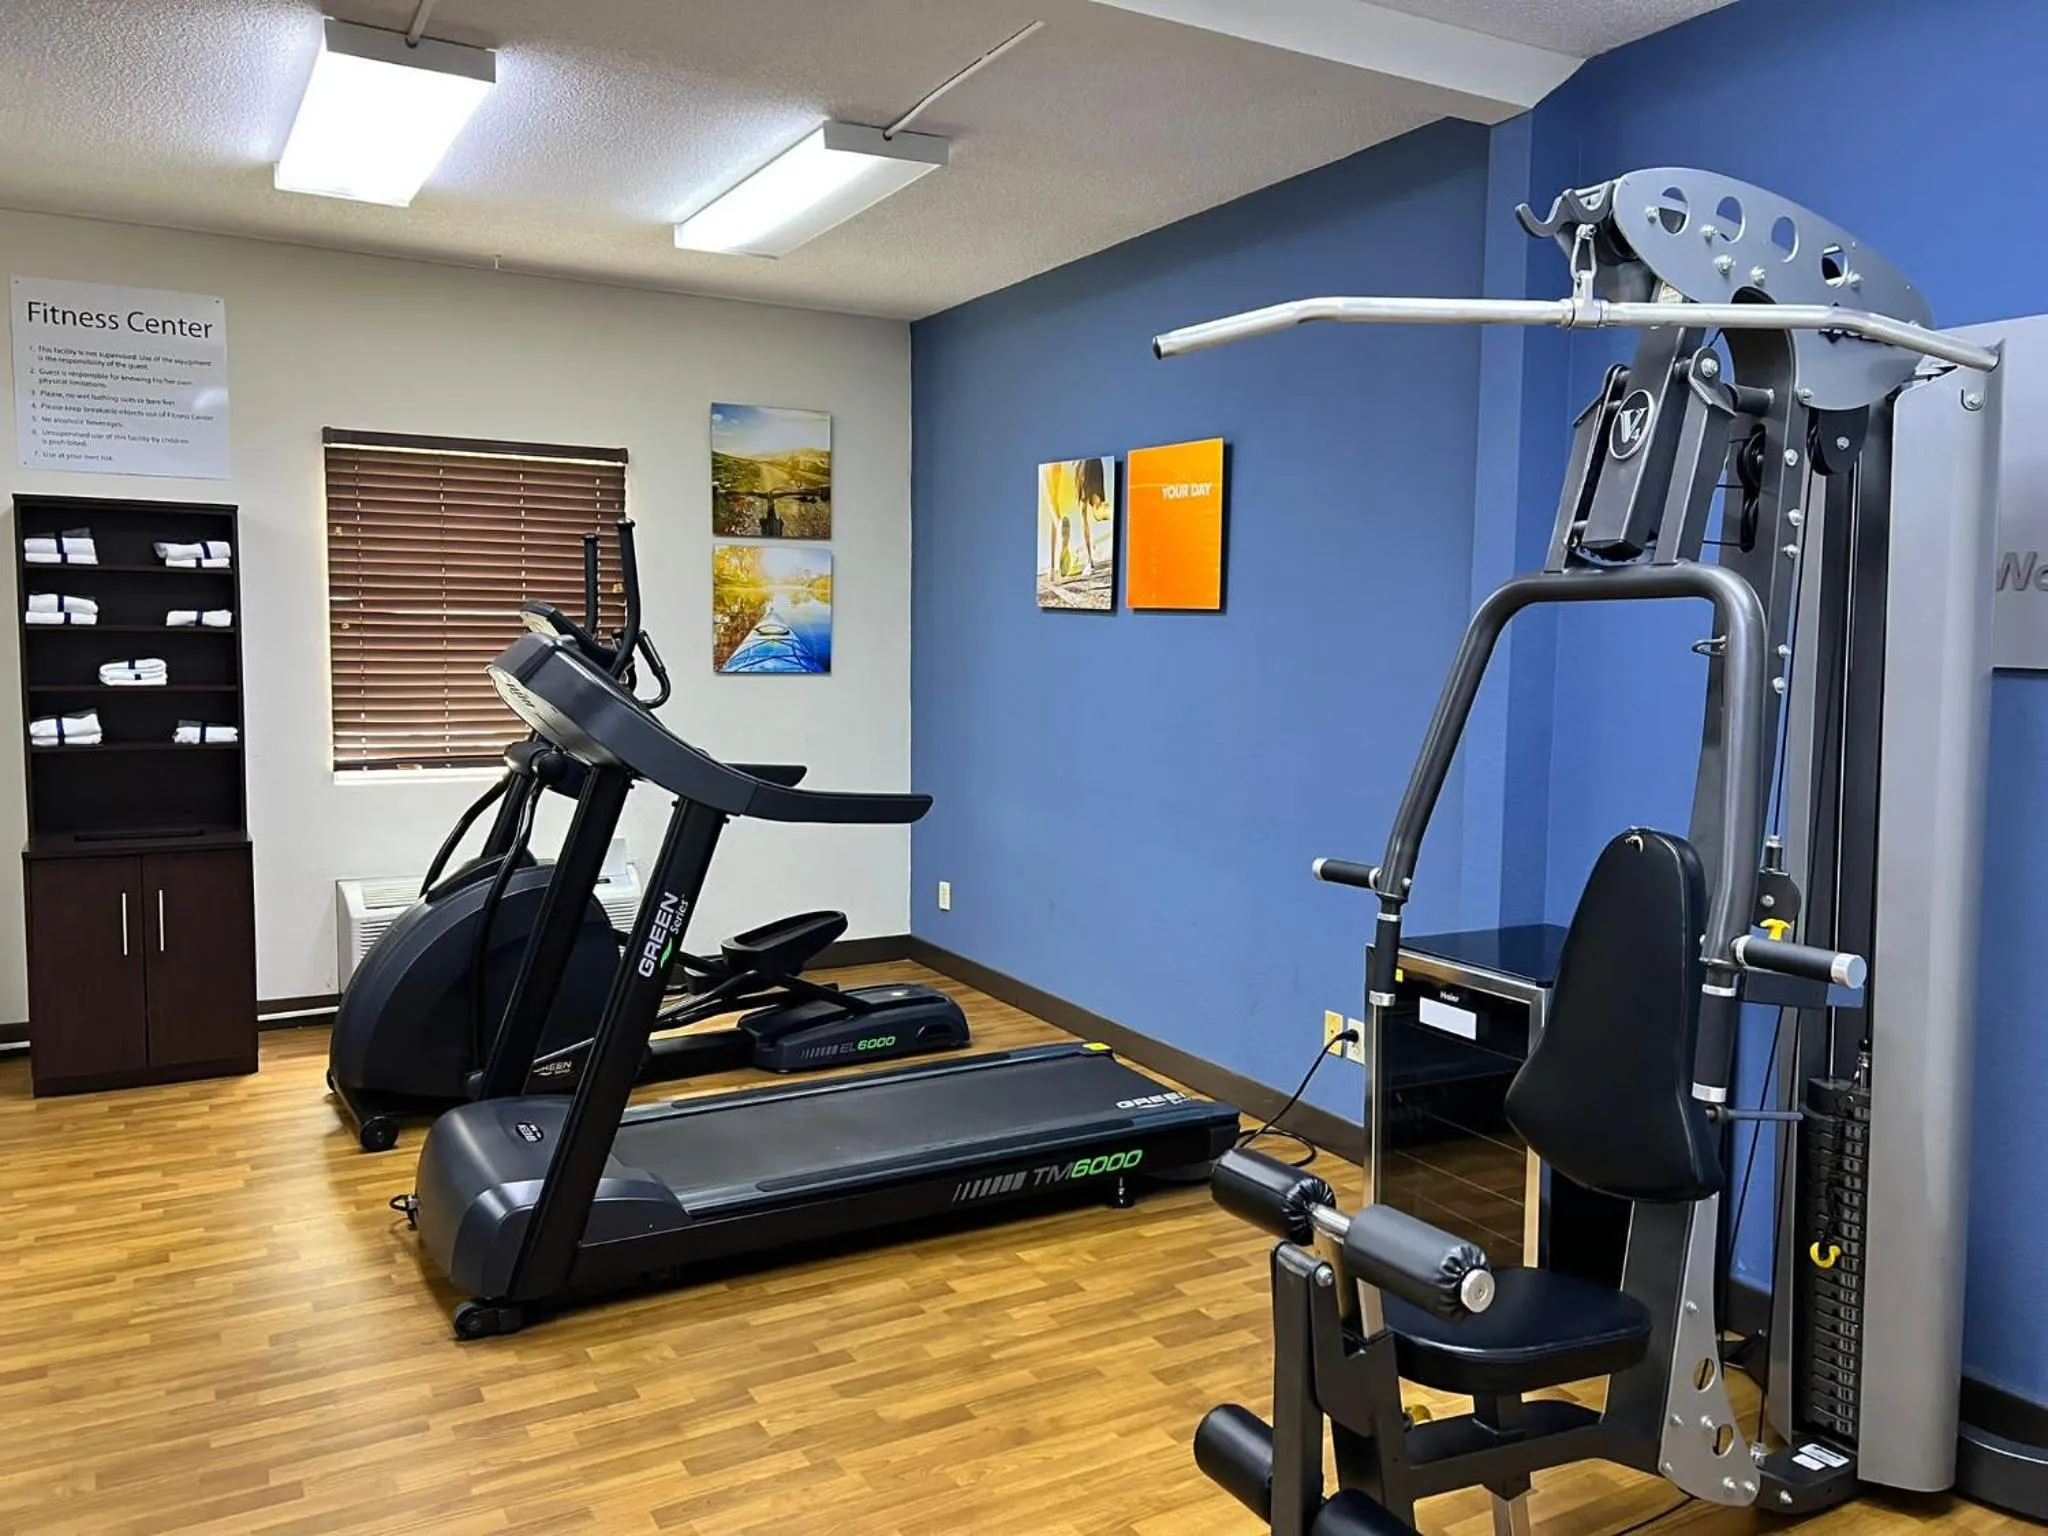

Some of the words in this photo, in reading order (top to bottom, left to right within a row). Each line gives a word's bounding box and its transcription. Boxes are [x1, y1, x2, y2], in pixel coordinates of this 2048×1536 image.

[27, 301, 119, 330] Fitness
[127, 310, 213, 339] Center
[153, 354, 161, 362] of
[38, 367, 60, 377] Guest
[68, 371, 109, 380] responsible
[110, 373, 120, 381] for
[121, 374, 151, 385] knowing
[41, 402, 63, 411] Please
[64, 404, 82, 413] keep
[1161, 483, 1189, 500] YOUR
[1190, 481, 1213, 497] DAY
[669, 899, 689, 935] Series
[638, 891, 679, 978] GREEN
[840, 1035, 896, 1054] EL6000
[1033, 1149, 1144, 1187] TM6000
